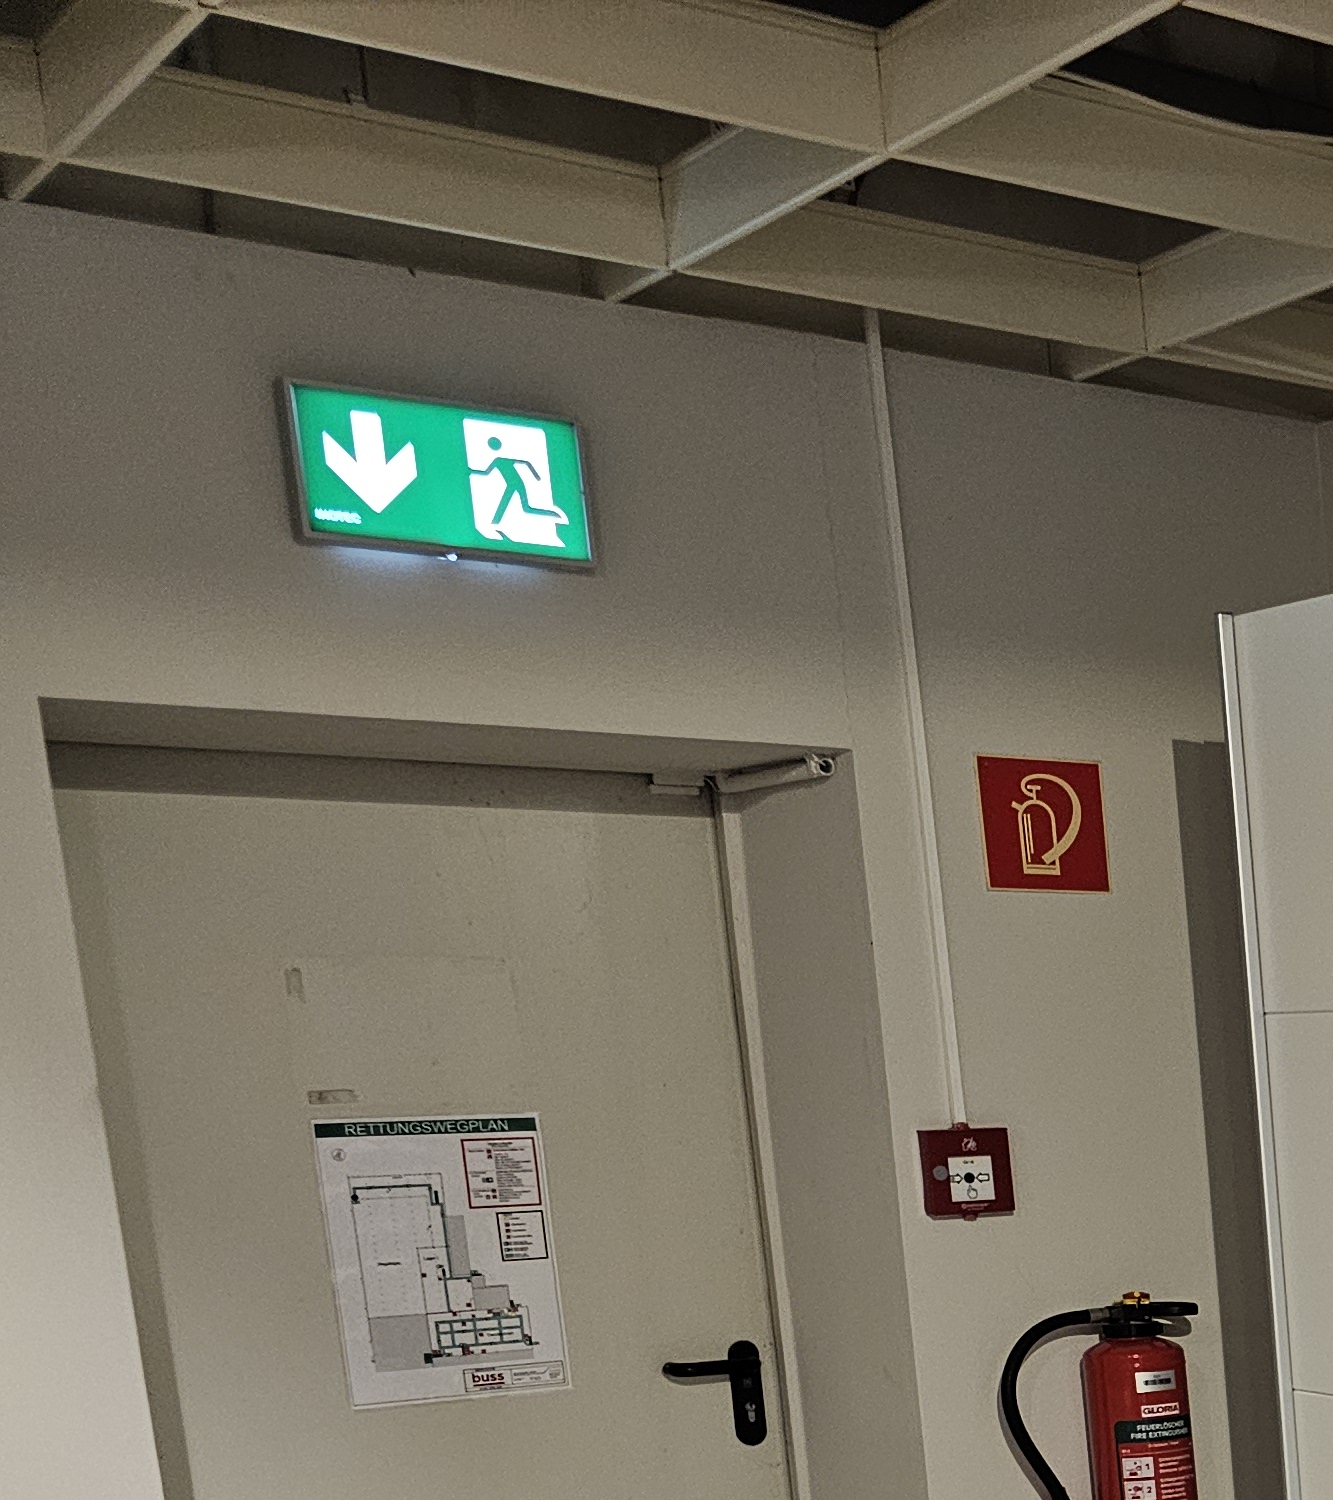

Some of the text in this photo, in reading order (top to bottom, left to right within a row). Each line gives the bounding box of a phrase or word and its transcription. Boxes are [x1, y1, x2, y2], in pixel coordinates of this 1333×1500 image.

[344, 1119, 509, 1136] RETTUNGSWEGPLAN
[472, 1373, 505, 1383] buss
[1143, 1405, 1178, 1414] GLORIA
